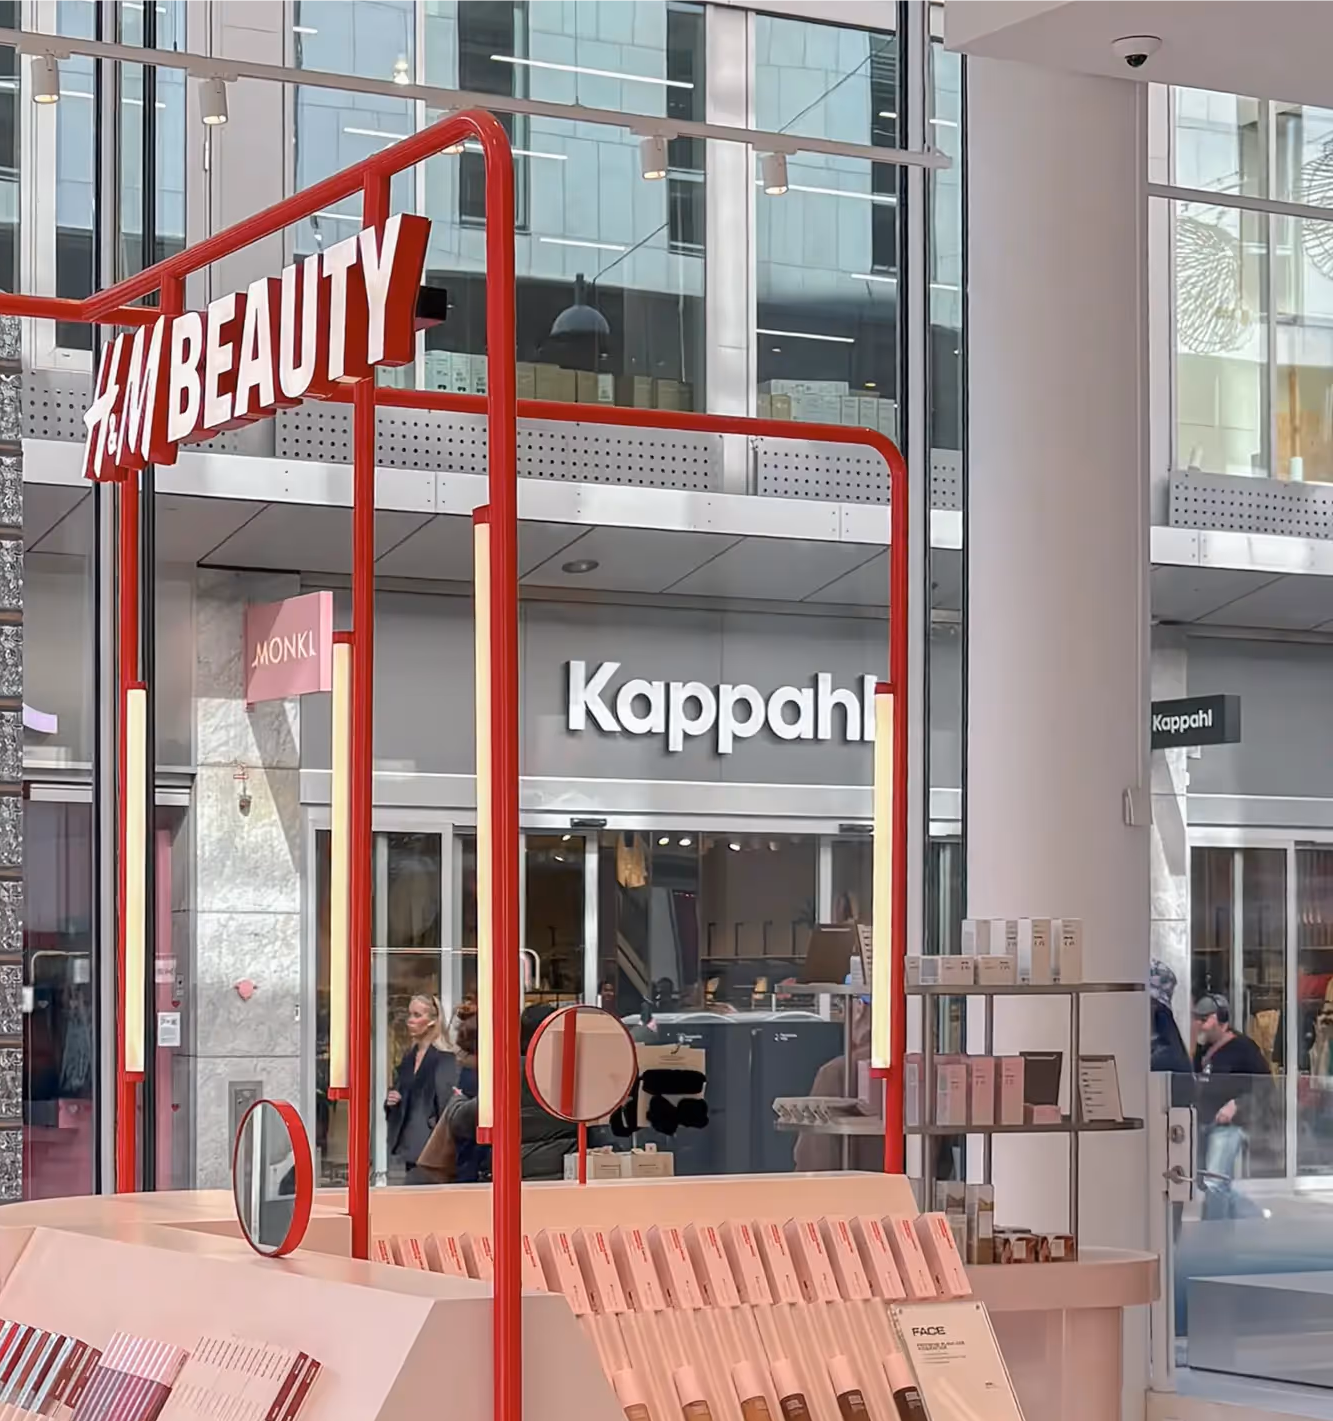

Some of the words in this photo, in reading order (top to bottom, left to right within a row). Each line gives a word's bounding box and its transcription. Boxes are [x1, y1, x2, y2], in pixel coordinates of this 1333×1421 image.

[81, 315, 165, 479] H&M
[167, 213, 429, 443] BEAUTY
[251, 629, 317, 668] MONKI
[569, 660, 877, 754] Kappahl
[1153, 708, 1213, 734] Kappahl
[912, 1326, 946, 1336] FACE
